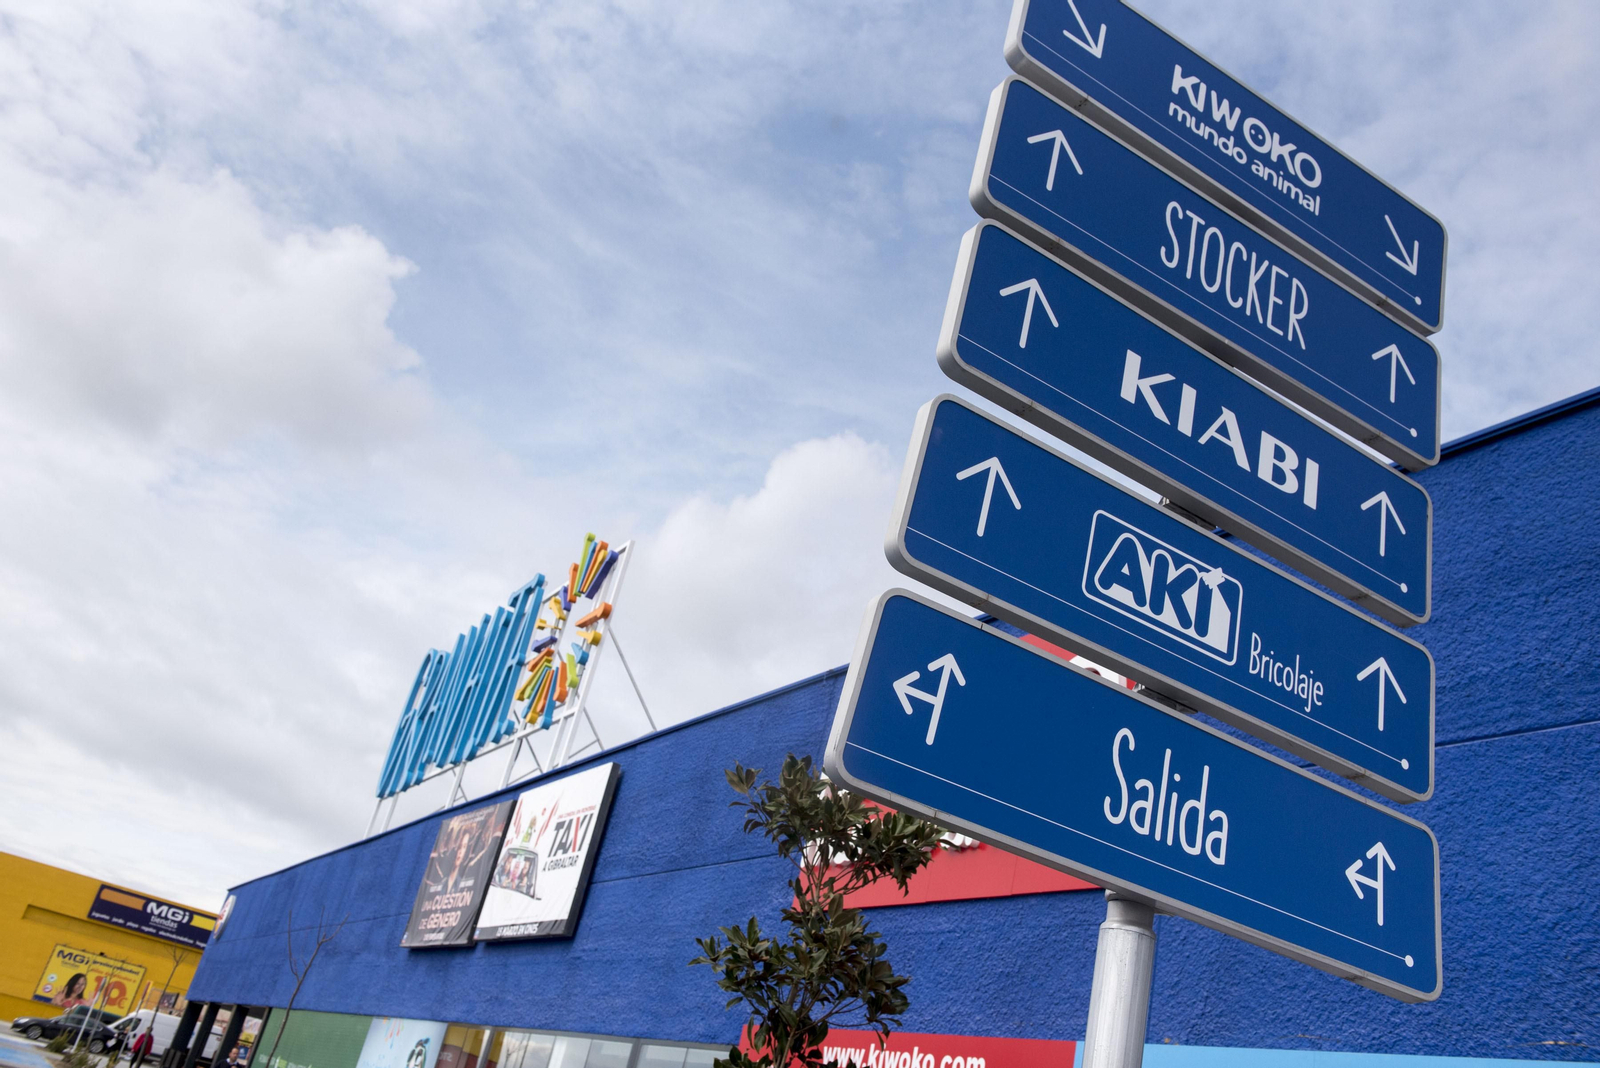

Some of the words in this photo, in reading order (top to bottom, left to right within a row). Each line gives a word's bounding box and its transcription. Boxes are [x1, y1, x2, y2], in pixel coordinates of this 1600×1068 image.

[1169, 101, 1247, 166] mundo
[1251, 161, 1321, 216] animal
[1171, 64, 1322, 188] KIWOKO
[1160, 201, 1309, 350] STOCKER
[1120, 349, 1320, 511] KIABI
[1094, 532, 1231, 653] AKI
[1249, 632, 1324, 713] Bricolaje
[547, 812, 594, 858] TAXI
[1103, 727, 1229, 866] Salida
[432, 888, 474, 911] CUESTIÓN
[547, 855, 580, 871] GIBRALTAR
[150, 915, 178, 929] tiendas
[426, 910, 462, 930] GÉNERO
[823, 1042, 986, 1068] www.kiwokocom
